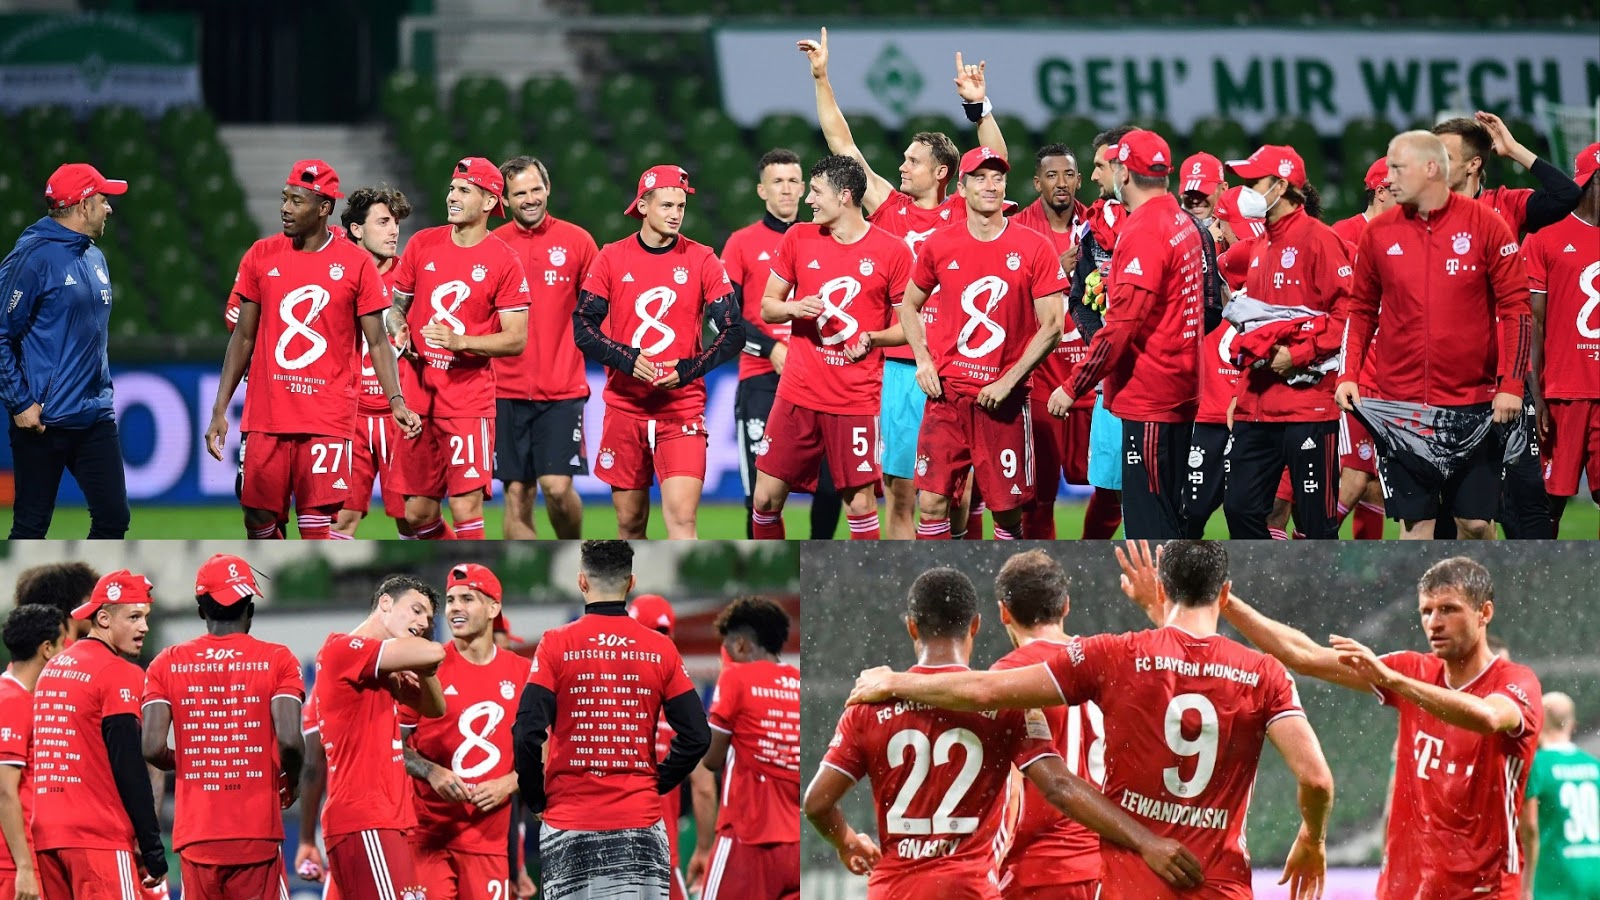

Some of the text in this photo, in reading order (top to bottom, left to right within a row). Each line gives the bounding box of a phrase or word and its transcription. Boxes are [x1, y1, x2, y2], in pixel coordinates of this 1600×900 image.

[1035, 57, 1191, 117] GEH'
[1211, 56, 1337, 117] MIR
[1358, 56, 1563, 117] WECH
[1192, 162, 1201, 175] 8
[632, 285, 677, 354] 8
[816, 275, 861, 346] 8
[957, 275, 1009, 359] 8
[274, 284, 330, 370] 8
[365, 386, 384, 395] -202
[450, 434, 475, 466] 21
[853, 426, 869, 457] 5
[311, 443, 343, 475] 27
[1000, 448, 1018, 479] 9
[228, 563, 239, 578] 8
[171, 662, 270, 673] DEUTSCHER MEISTER
[564, 649, 662, 664] DEUTSCHER MEISTER
[1136, 657, 1151, 673] FC
[1155, 656, 1200, 677] BAYERN
[452, 701, 505, 779] 8
[1163, 693, 1219, 799] 9
[886, 728, 984, 835] 22
[1120, 788, 1229, 830] LEWANDOWSKI
[898, 838, 961, 860] GNABRY
